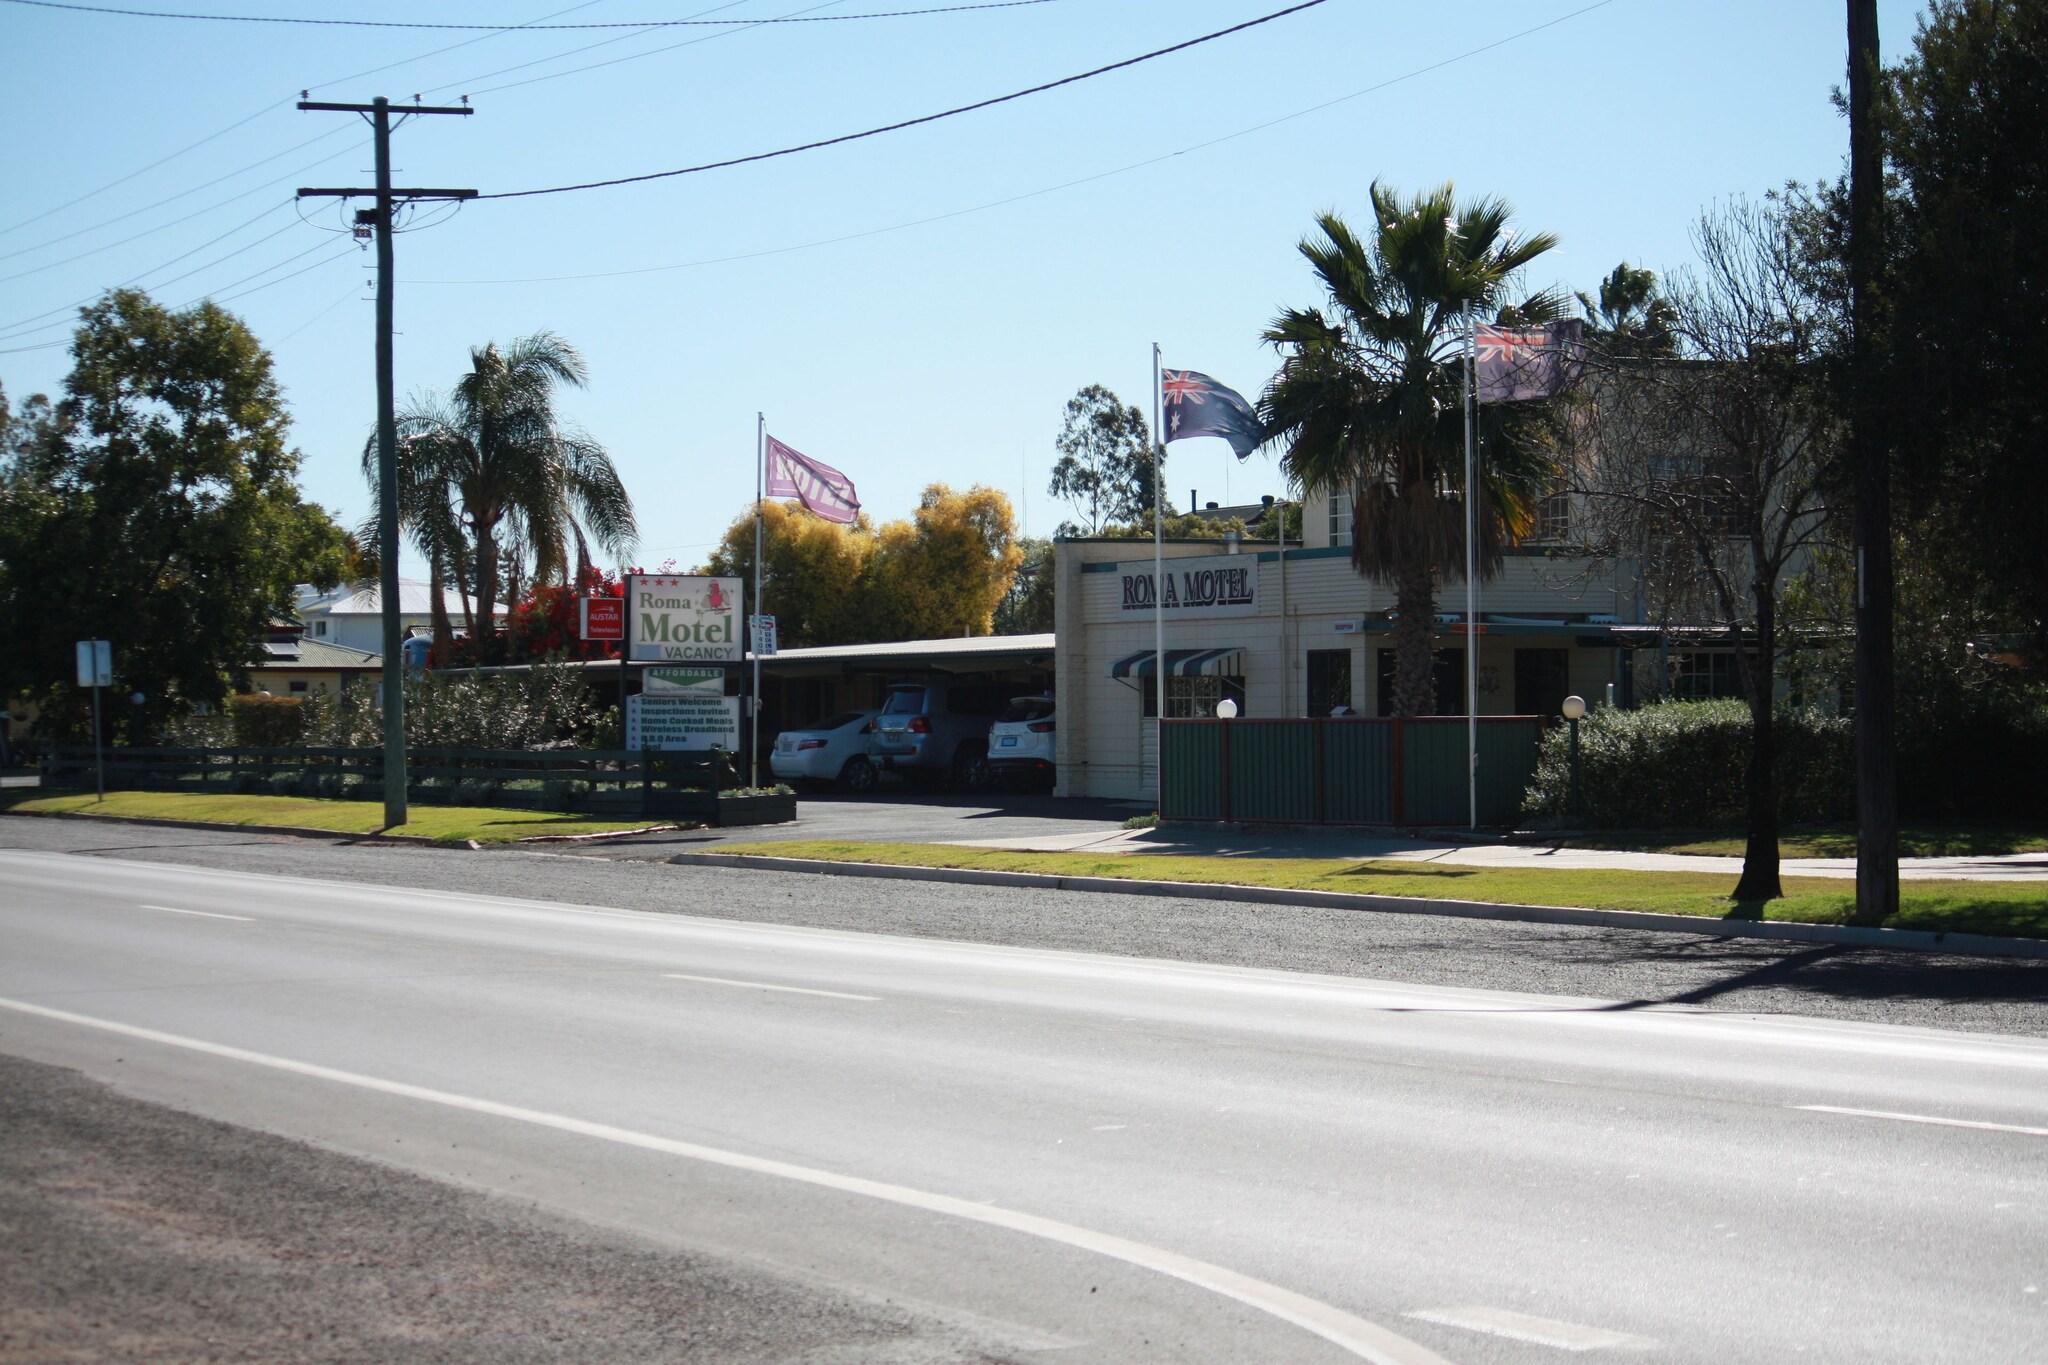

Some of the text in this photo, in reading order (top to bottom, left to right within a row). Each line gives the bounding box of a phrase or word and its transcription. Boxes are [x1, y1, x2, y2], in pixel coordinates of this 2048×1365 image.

[1183, 568, 1254, 606] MOTEL
[639, 593, 691, 609] Roma
[590, 613, 619, 621] AUSTAR
[640, 612, 733, 643] Motel
[664, 646, 733, 660] VACANCY
[652, 668, 719, 677] AFFORDABLE
[641, 698, 722, 706] Seniors Welcome
[641, 708, 696, 716] Inspections
[641, 717, 734, 725] Home Cooked Meals
[684, 725, 735, 733] Broadband
[665, 735, 687, 743] Area
